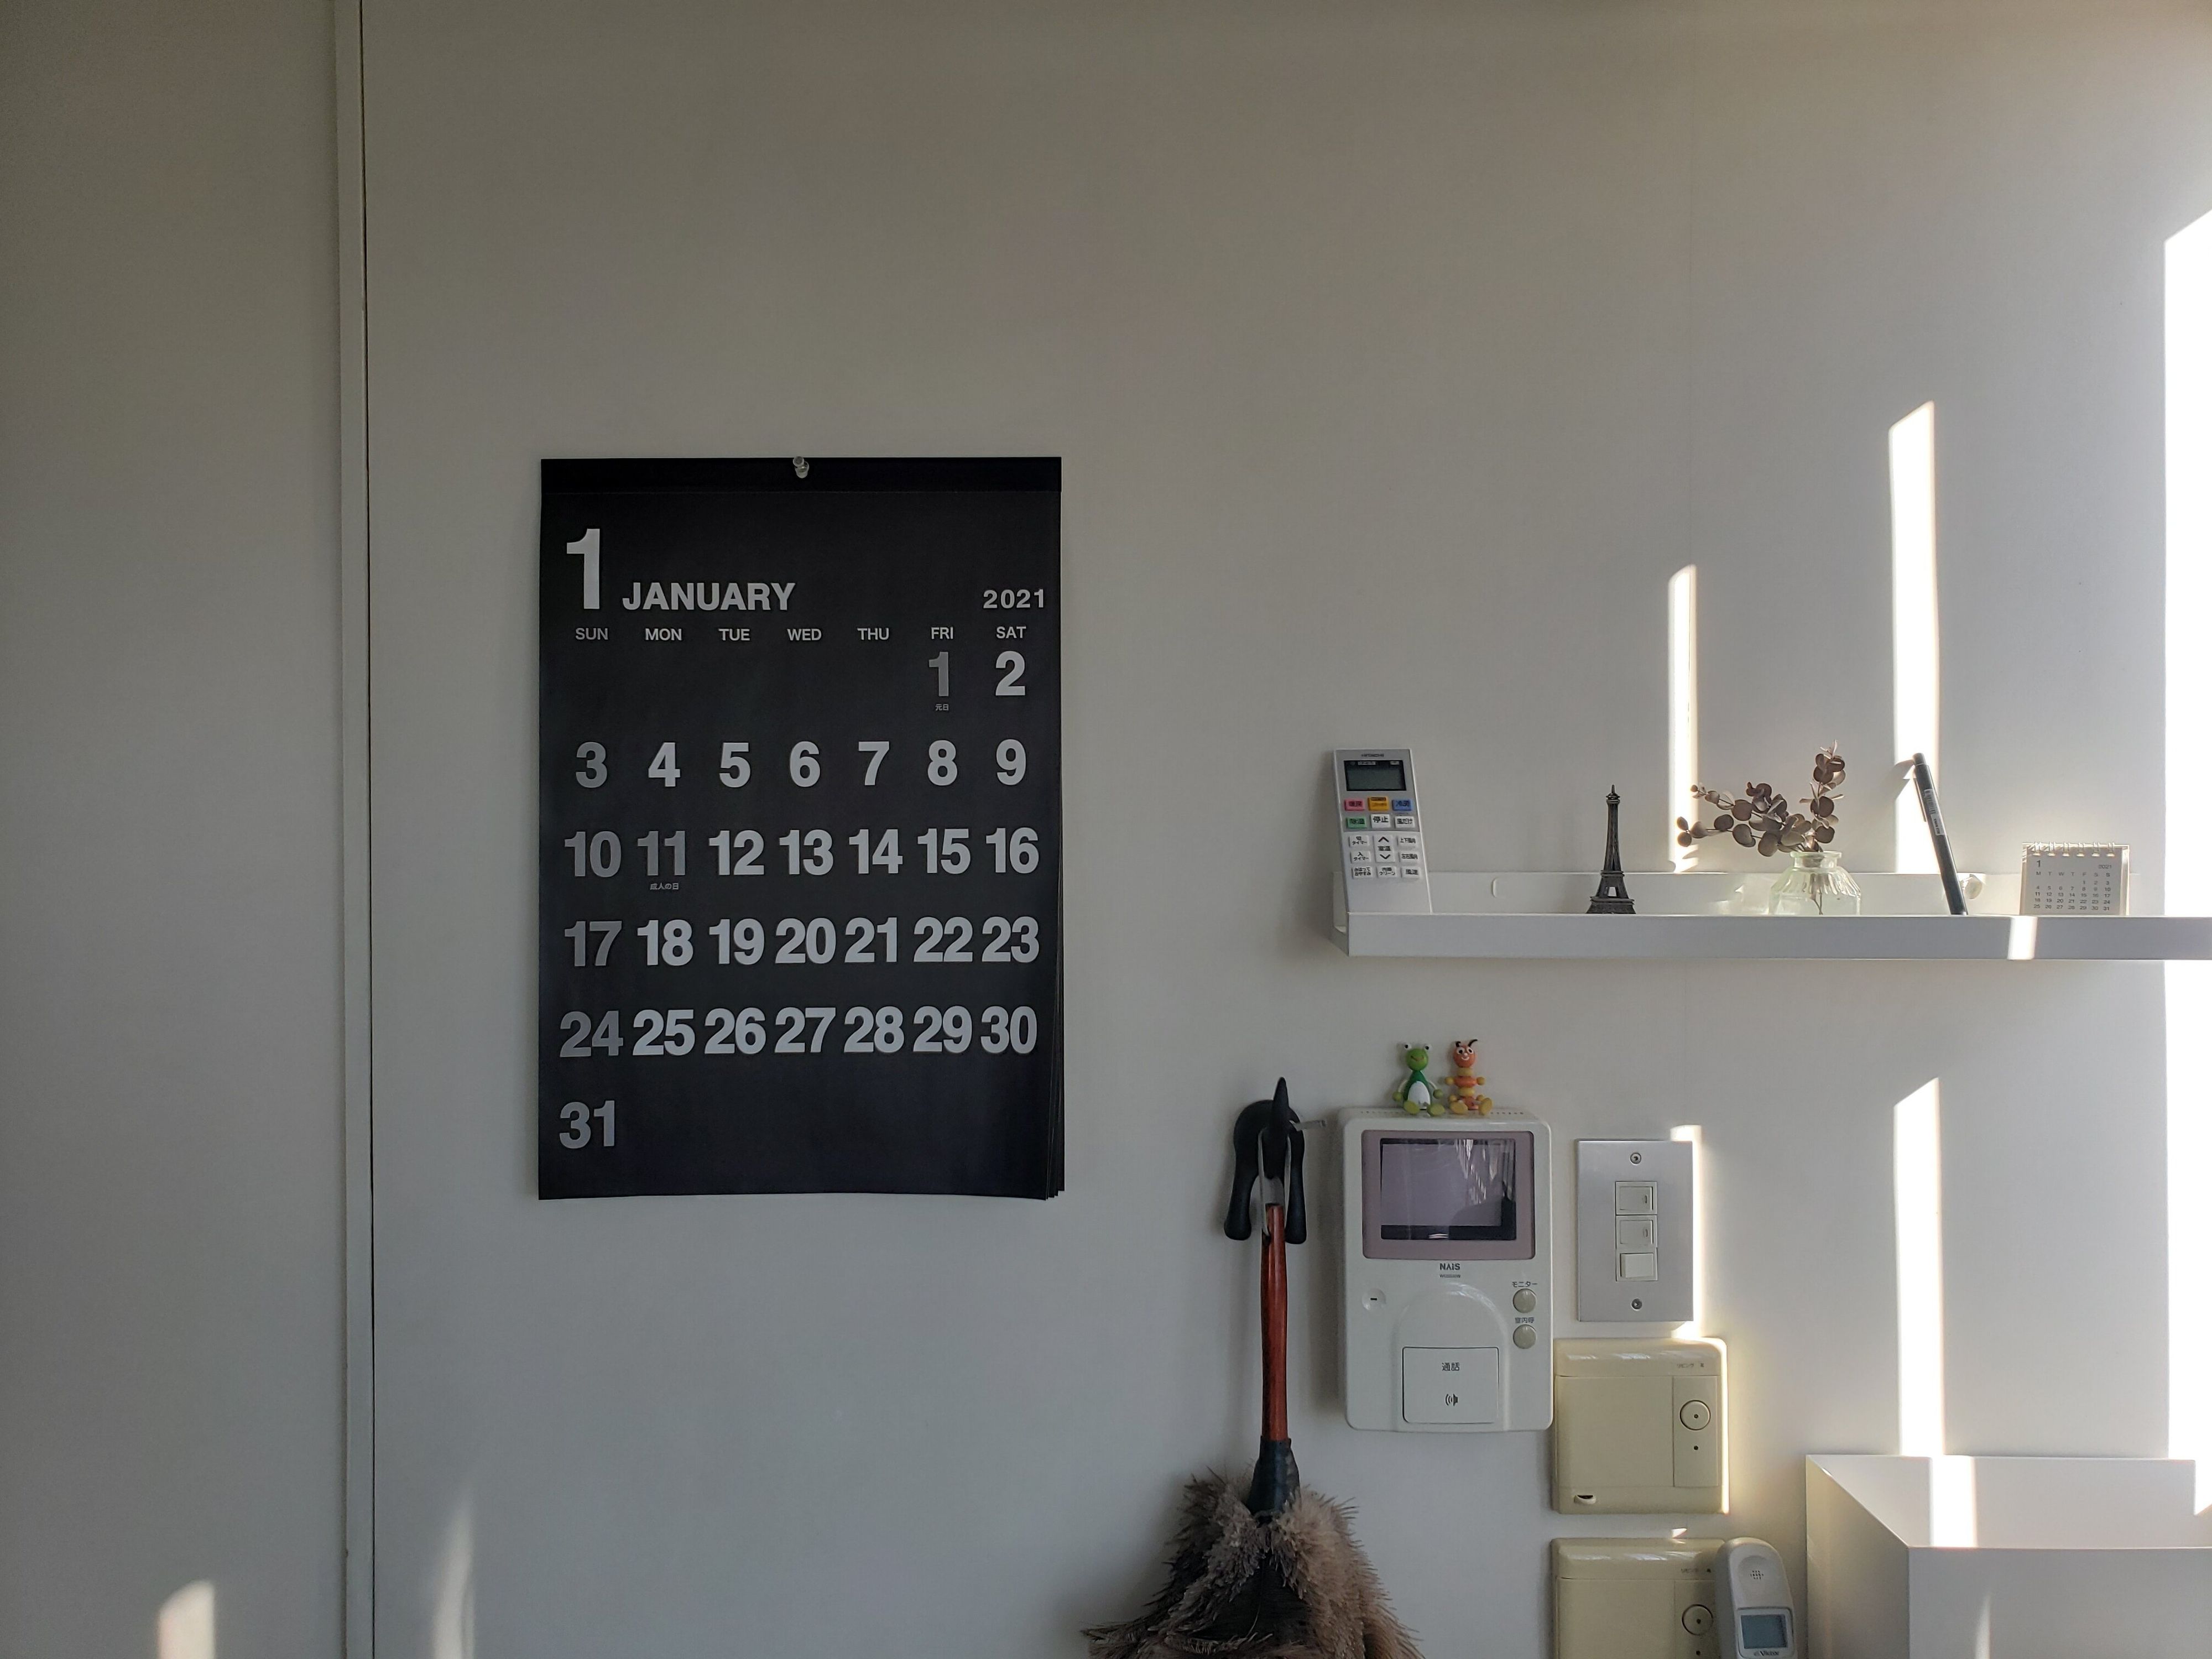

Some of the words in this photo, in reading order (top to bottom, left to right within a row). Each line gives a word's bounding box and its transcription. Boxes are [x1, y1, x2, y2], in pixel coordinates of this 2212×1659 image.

[566, 528, 600, 609] 1
[622, 582, 796, 611] JANUARY
[983, 588, 1044, 609] 2021
[575, 628, 609, 640] SUN
[645, 628, 682, 641] MON
[718, 628, 750, 641] TUE
[787, 628, 822, 641] WED
[857, 627, 890, 641] THU
[931, 627, 954, 640] FRI
[996, 626, 1026, 639] SAT
[928, 651, 950, 697] 1
[995, 650, 1026, 696] 2
[576, 742, 608, 789] 3
[648, 742, 681, 787] 4
[719, 742, 751, 788] 5
[789, 741, 821, 787] 6
[858, 741, 890, 786] 7
[927, 739, 958, 786] 8
[996, 739, 1026, 786] 9
[565, 831, 622, 878] 10
[637, 831, 686, 876] 11
[708, 830, 764, 875] 12
[779, 829, 834, 875] 13
[849, 828, 903, 874] 14
[917, 828, 971, 874] 15
[985, 827, 1039, 874] 16
[565, 921, 622, 967] 17
[637, 919, 693, 966] 18
[709, 918, 765, 965] 19
[775, 917, 836, 964] 20
[844, 917, 898, 963] 21
[913, 916, 973, 962] 22
[982, 916, 1040, 963] 23
[560, 1010, 624, 1057] 24
[632, 1009, 695, 1056] 25
[704, 1008, 766, 1055] 26
[774, 1007, 836, 1053] 27
[843, 1006, 905, 1053] 28
[912, 1006, 972, 1053] 29
[980, 1006, 1037, 1054] 30
[559, 1100, 615, 1149] 31
[1442, 1362, 1460, 1371] 通話
